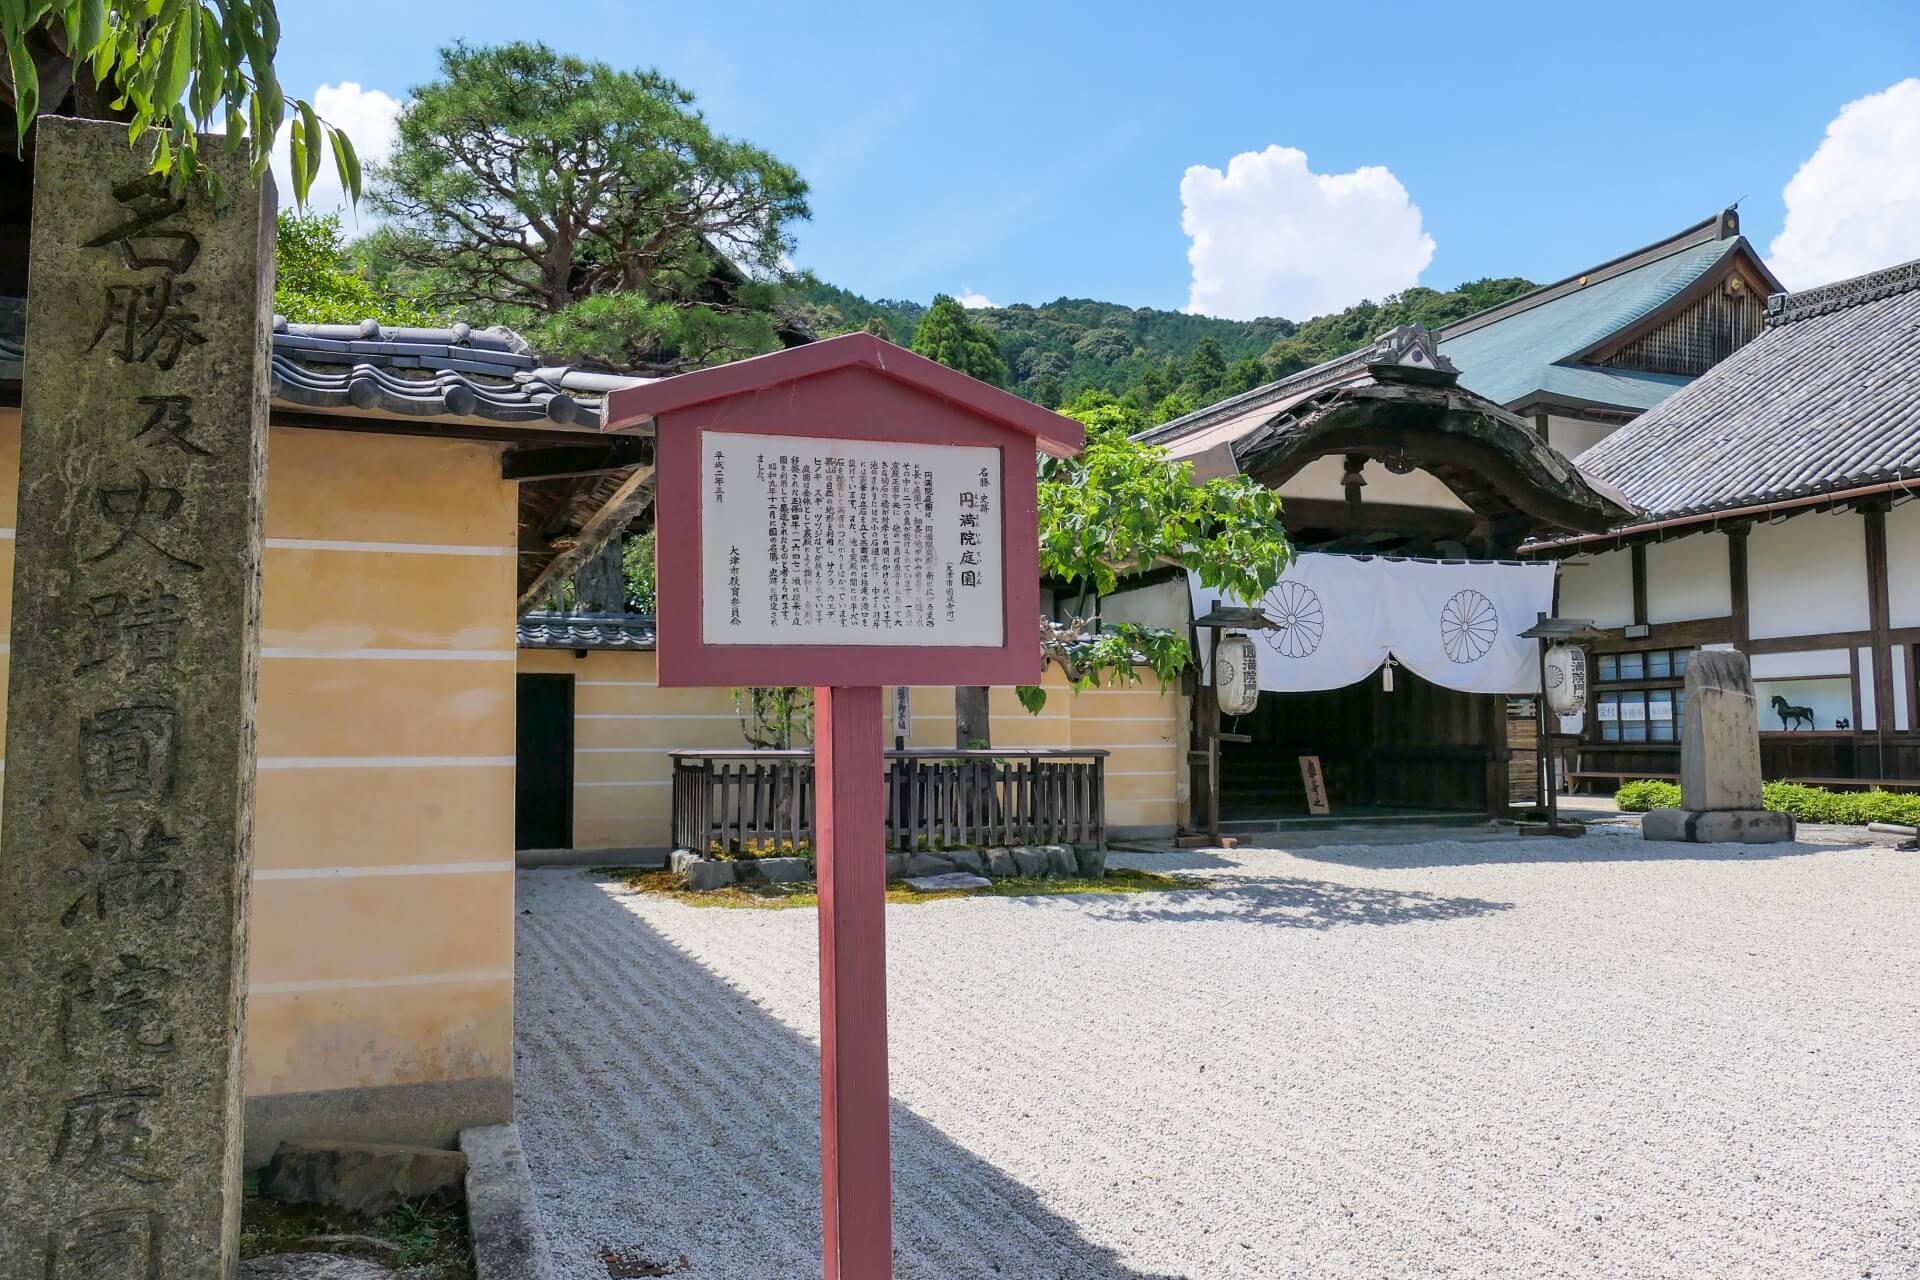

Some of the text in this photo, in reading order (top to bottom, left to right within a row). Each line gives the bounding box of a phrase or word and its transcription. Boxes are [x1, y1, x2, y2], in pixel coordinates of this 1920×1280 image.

[714, 451, 724, 503] 平成二年三月
[960, 491, 978, 587] 円満院庭園
